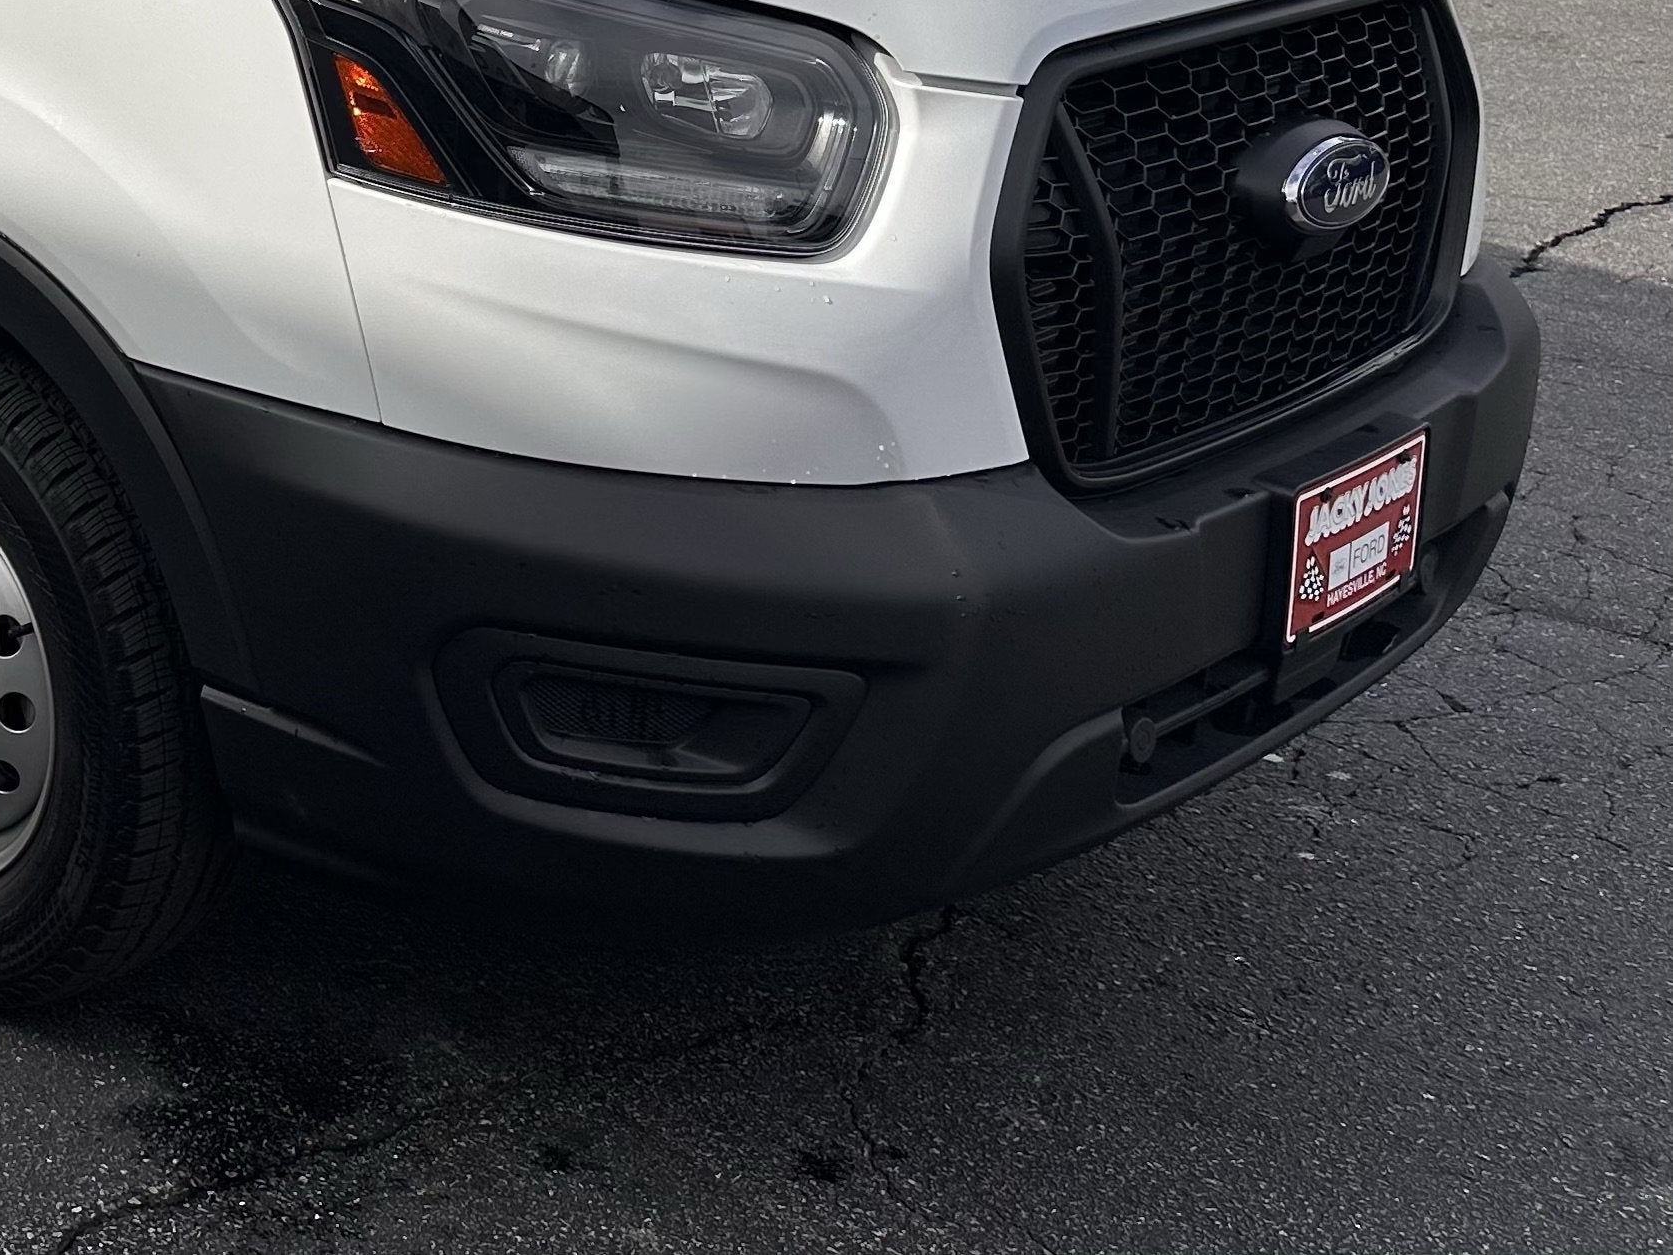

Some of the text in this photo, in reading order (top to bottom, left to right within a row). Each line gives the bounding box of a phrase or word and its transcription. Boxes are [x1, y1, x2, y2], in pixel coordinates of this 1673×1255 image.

[1324, 154, 1378, 213] Ford
[1305, 455, 1417, 546] JACKY JONES
[1352, 534, 1386, 570] FORD
[1376, 561, 1387, 580] NC
